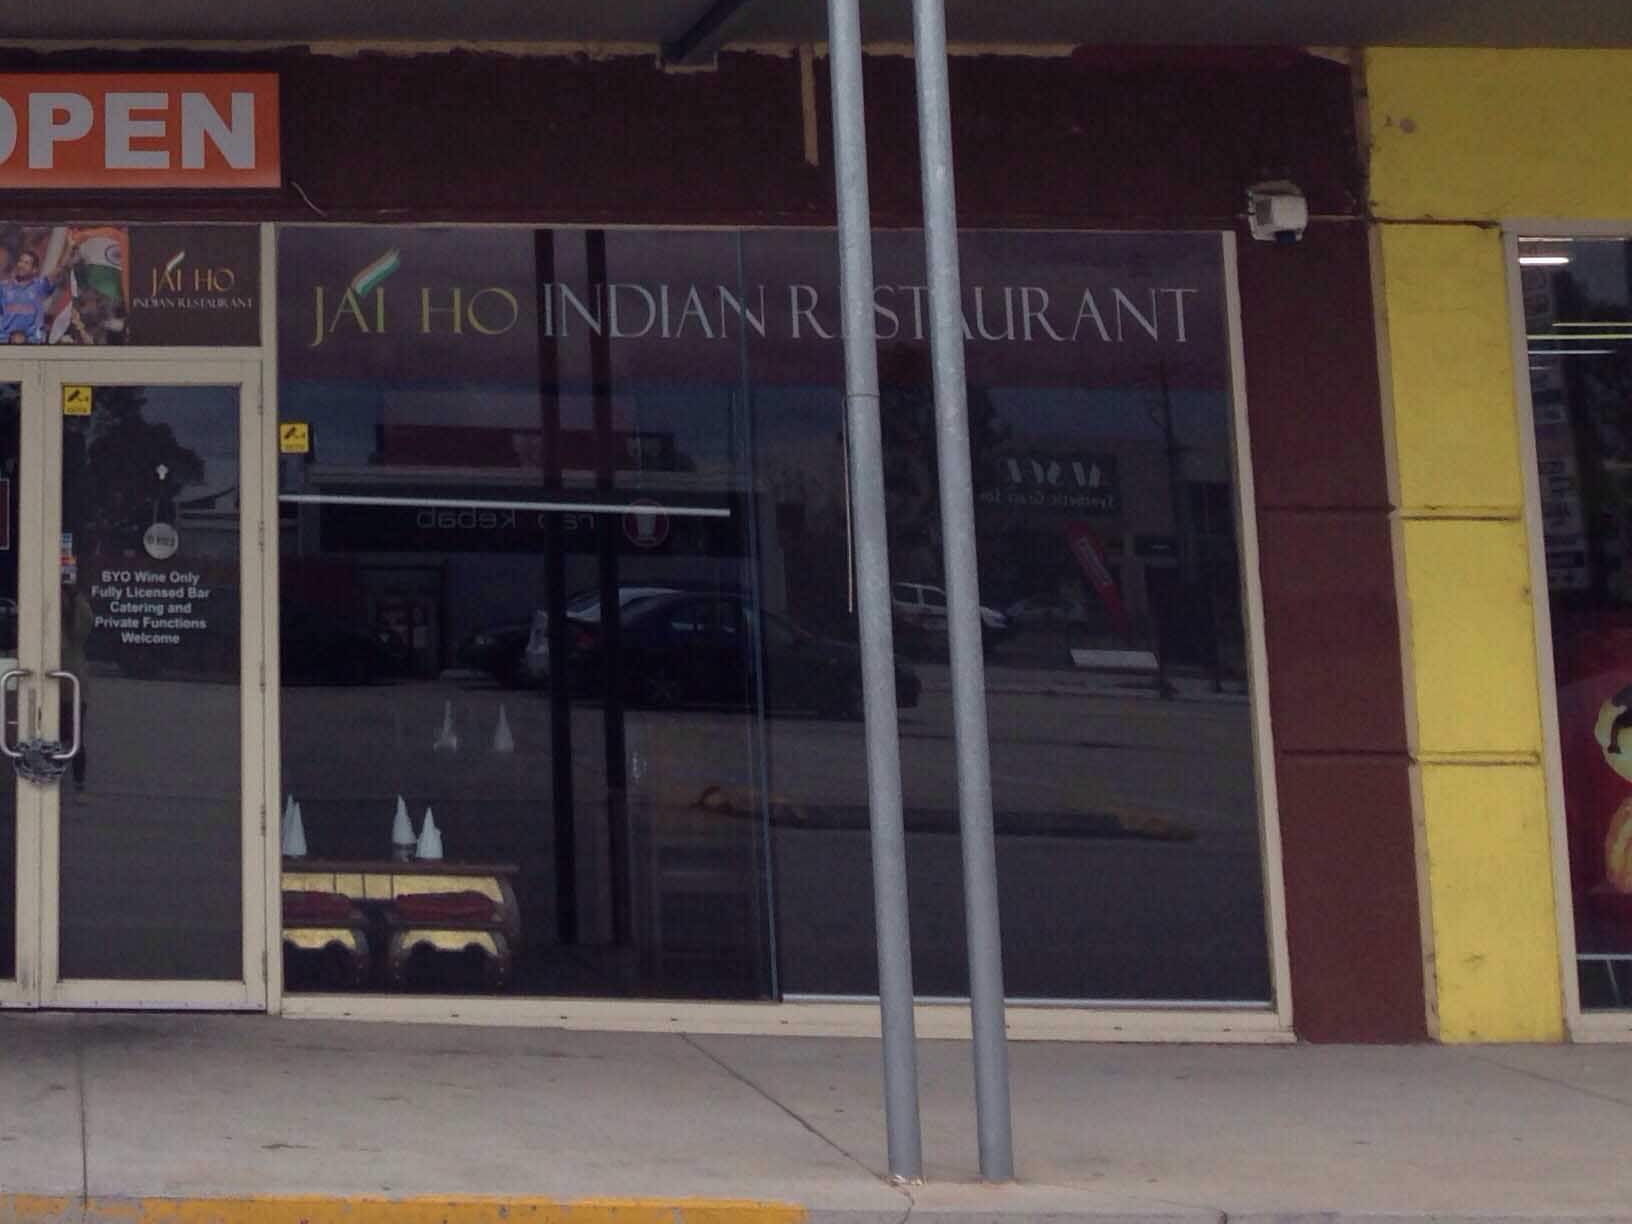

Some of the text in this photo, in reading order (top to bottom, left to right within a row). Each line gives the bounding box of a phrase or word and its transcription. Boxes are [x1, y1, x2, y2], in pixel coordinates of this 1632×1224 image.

[151, 267, 235, 297] JAI HO
[308, 283, 1199, 346] JAI HO INDIAN RSTURANT
[101, 571, 201, 586] BYO Wine Only
[91, 586, 211, 600] Fully Licensed Bar
[110, 601, 192, 615] Catering and
[95, 616, 207, 629] Private Functions
[121, 631, 180, 644] Welcome
